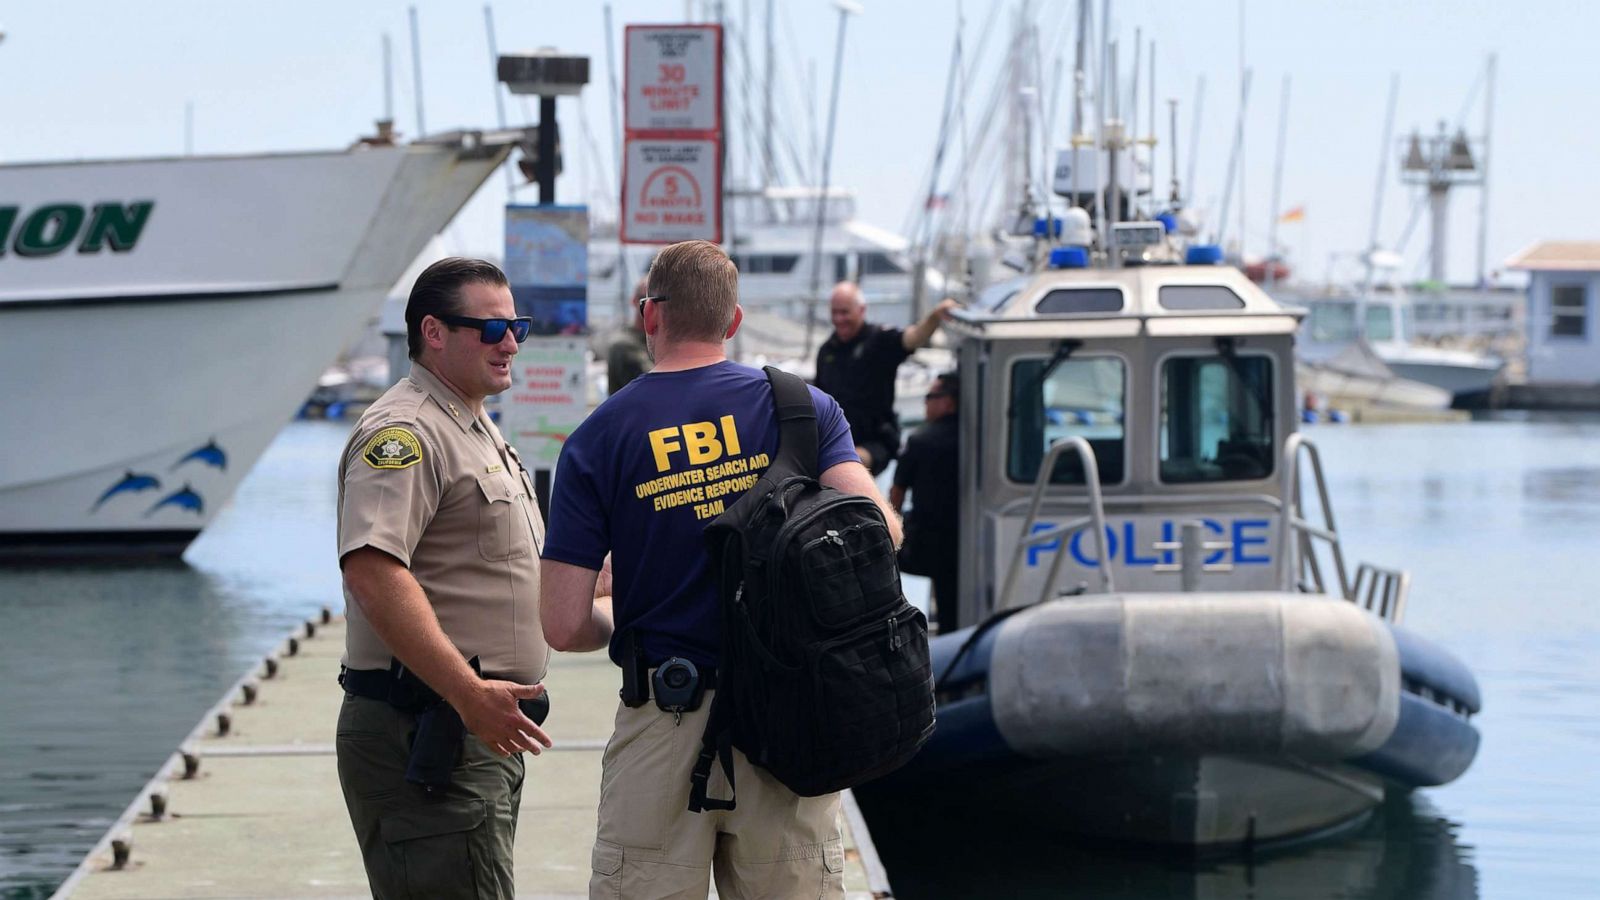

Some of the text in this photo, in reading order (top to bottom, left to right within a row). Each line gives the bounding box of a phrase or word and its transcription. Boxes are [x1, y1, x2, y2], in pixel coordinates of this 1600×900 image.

[658, 64, 686, 83] 30
[641, 85, 700, 97] MINUTE
[649, 98, 691, 111] LIMIT
[664, 176, 678, 194] 5
[635, 212, 657, 224] NO
[648, 415, 741, 472] FBI
[635, 453, 770, 499] UNDERWATER SEARCH AND
[653, 474, 759, 512] EVIDENCE RESPONSE
[694, 500, 725, 520] TEAM
